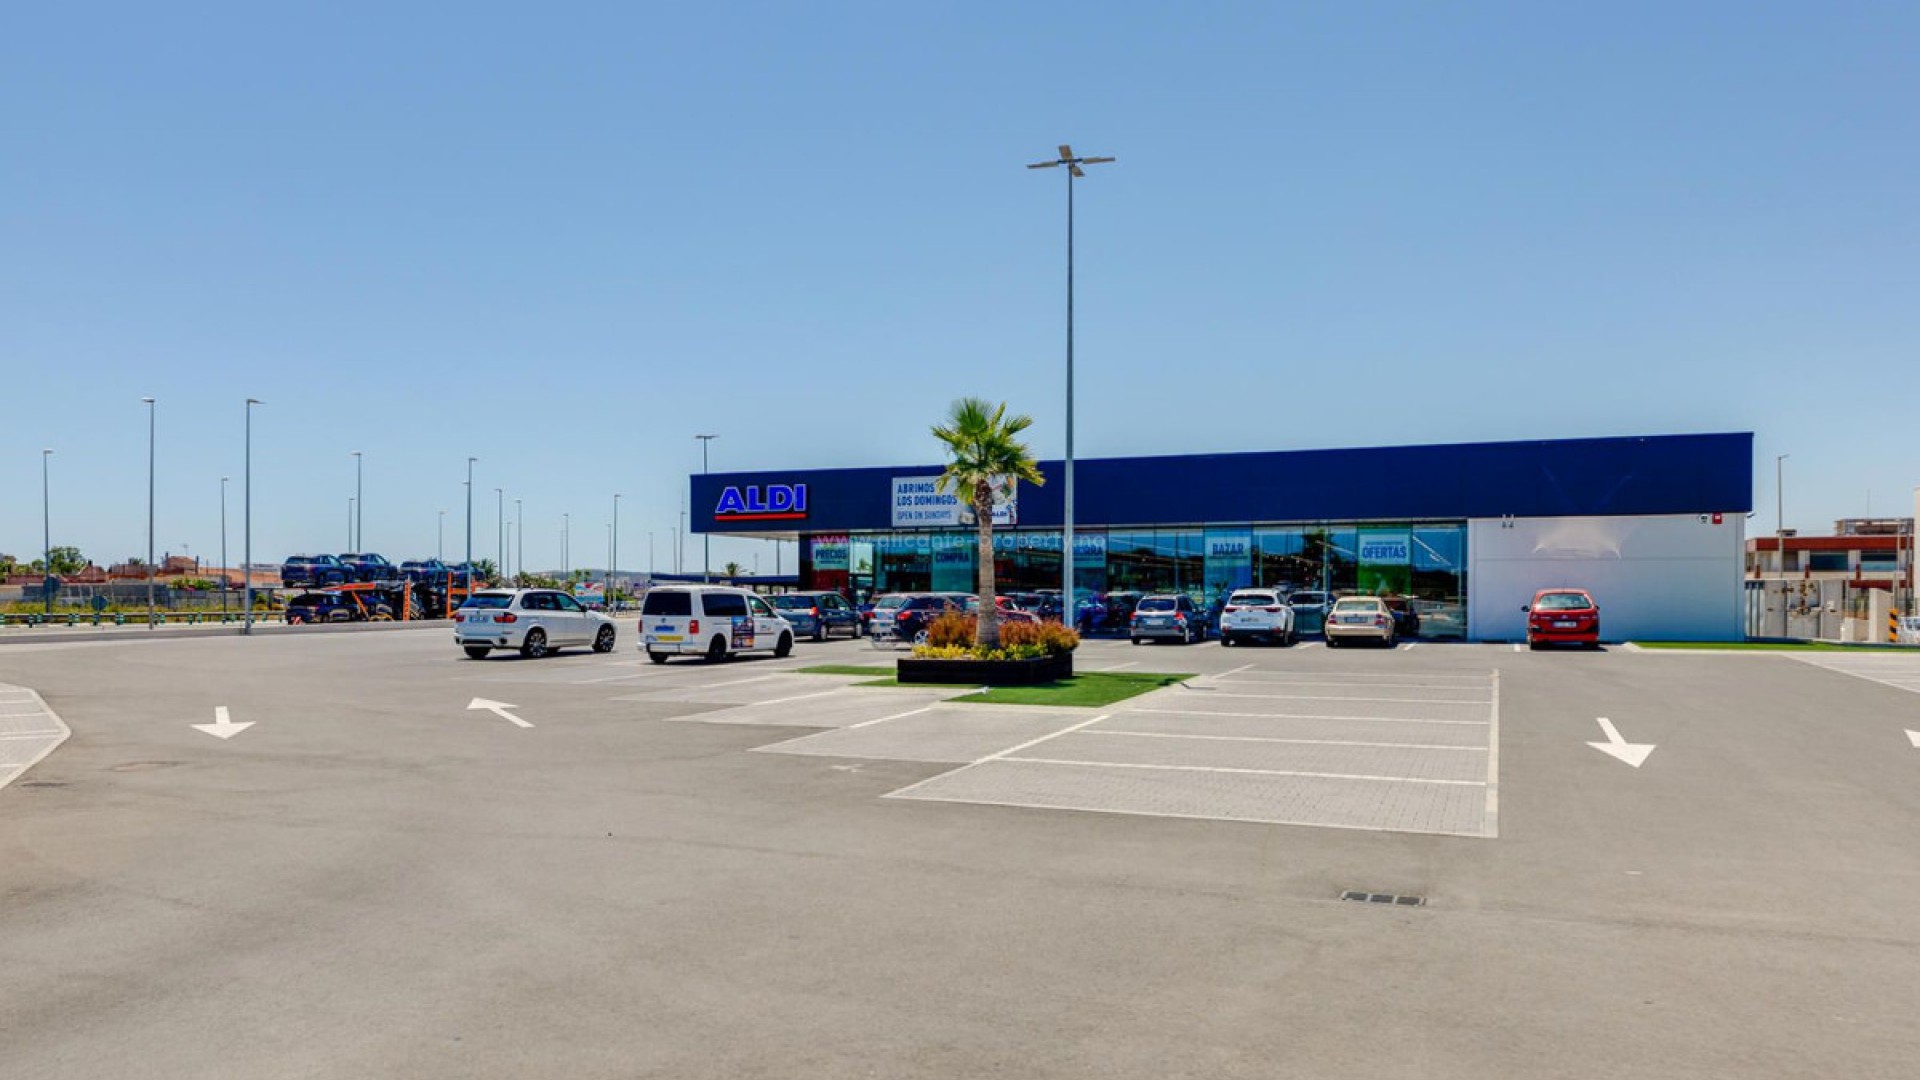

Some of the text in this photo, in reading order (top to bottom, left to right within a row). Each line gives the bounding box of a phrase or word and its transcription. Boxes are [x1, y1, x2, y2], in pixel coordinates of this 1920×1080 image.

[897, 483, 936, 494] ABRIMOS
[715, 484, 806, 513] ALDI
[897, 494, 958, 507] LOS DOMINGOS
[897, 510, 952, 520] OPEN ON SUNDAYS
[815, 549, 848, 560] PRECIOS
[1212, 542, 1244, 555] BAZAR
[1362, 545, 1407, 559] OFERTAS
[935, 551, 969, 562] COMPRA
